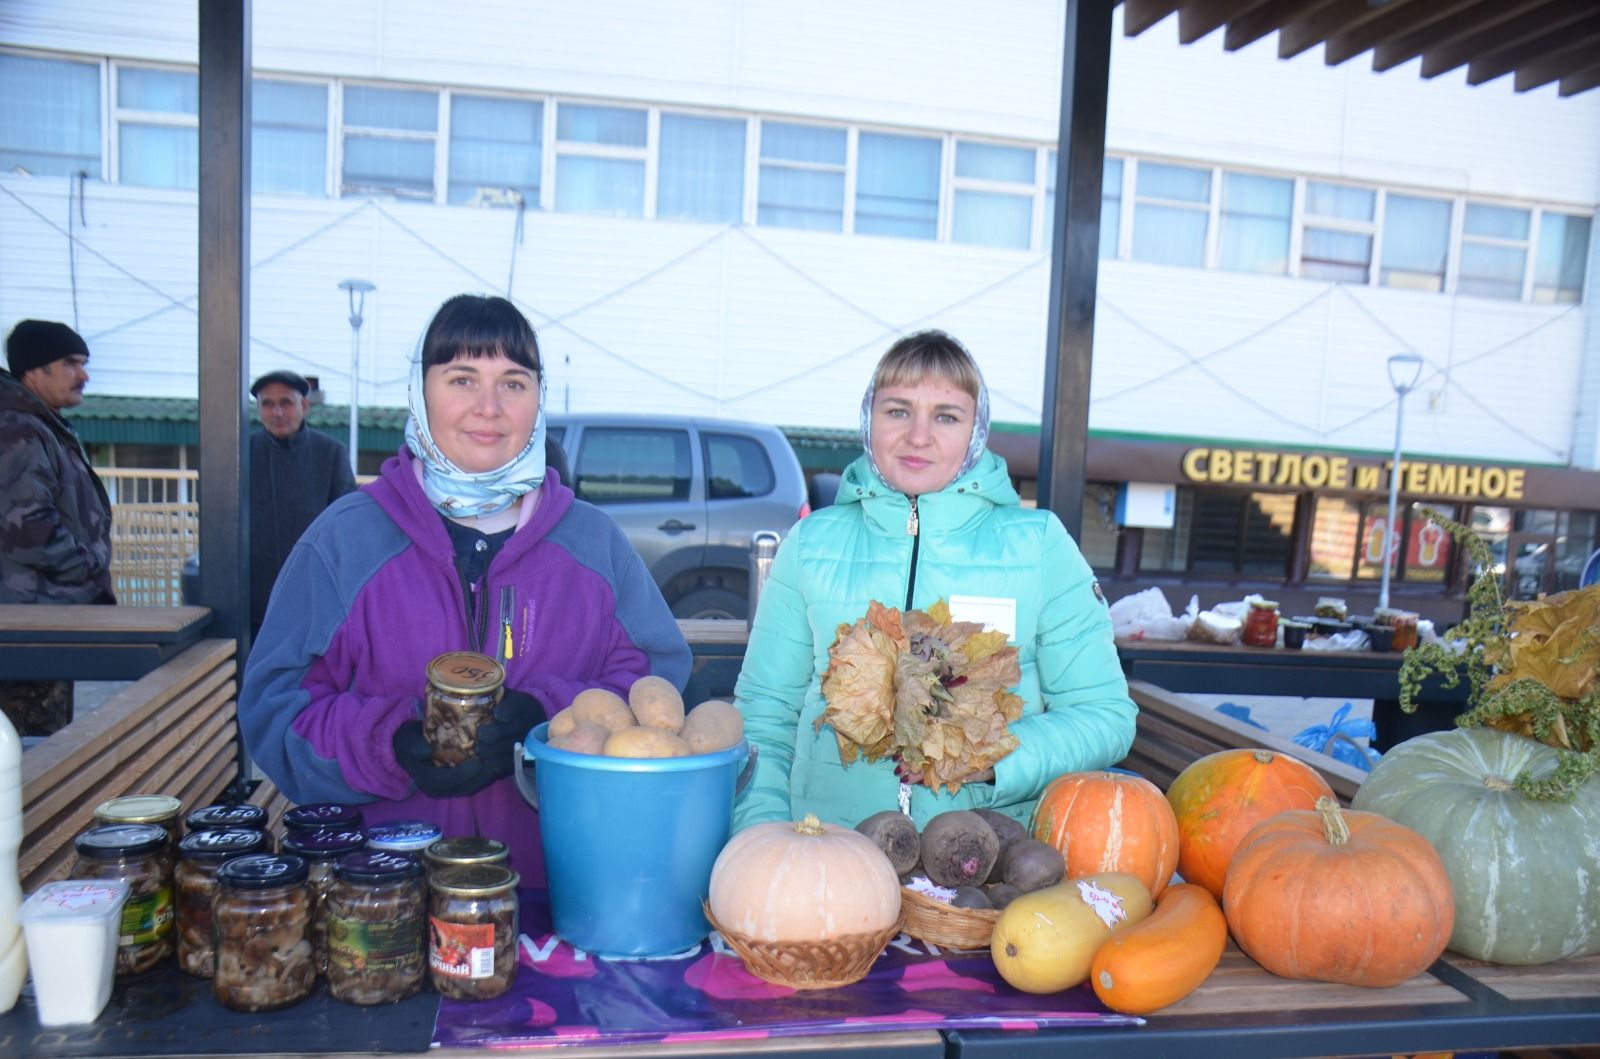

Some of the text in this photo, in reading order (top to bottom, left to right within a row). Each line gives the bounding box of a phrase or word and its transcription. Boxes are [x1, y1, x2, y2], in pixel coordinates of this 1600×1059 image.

[1183, 448, 1348, 488] СВЕТЛОЕ
[1386, 460, 1526, 499] ТЕМНОЕ
[200, 832, 251, 845] 450
